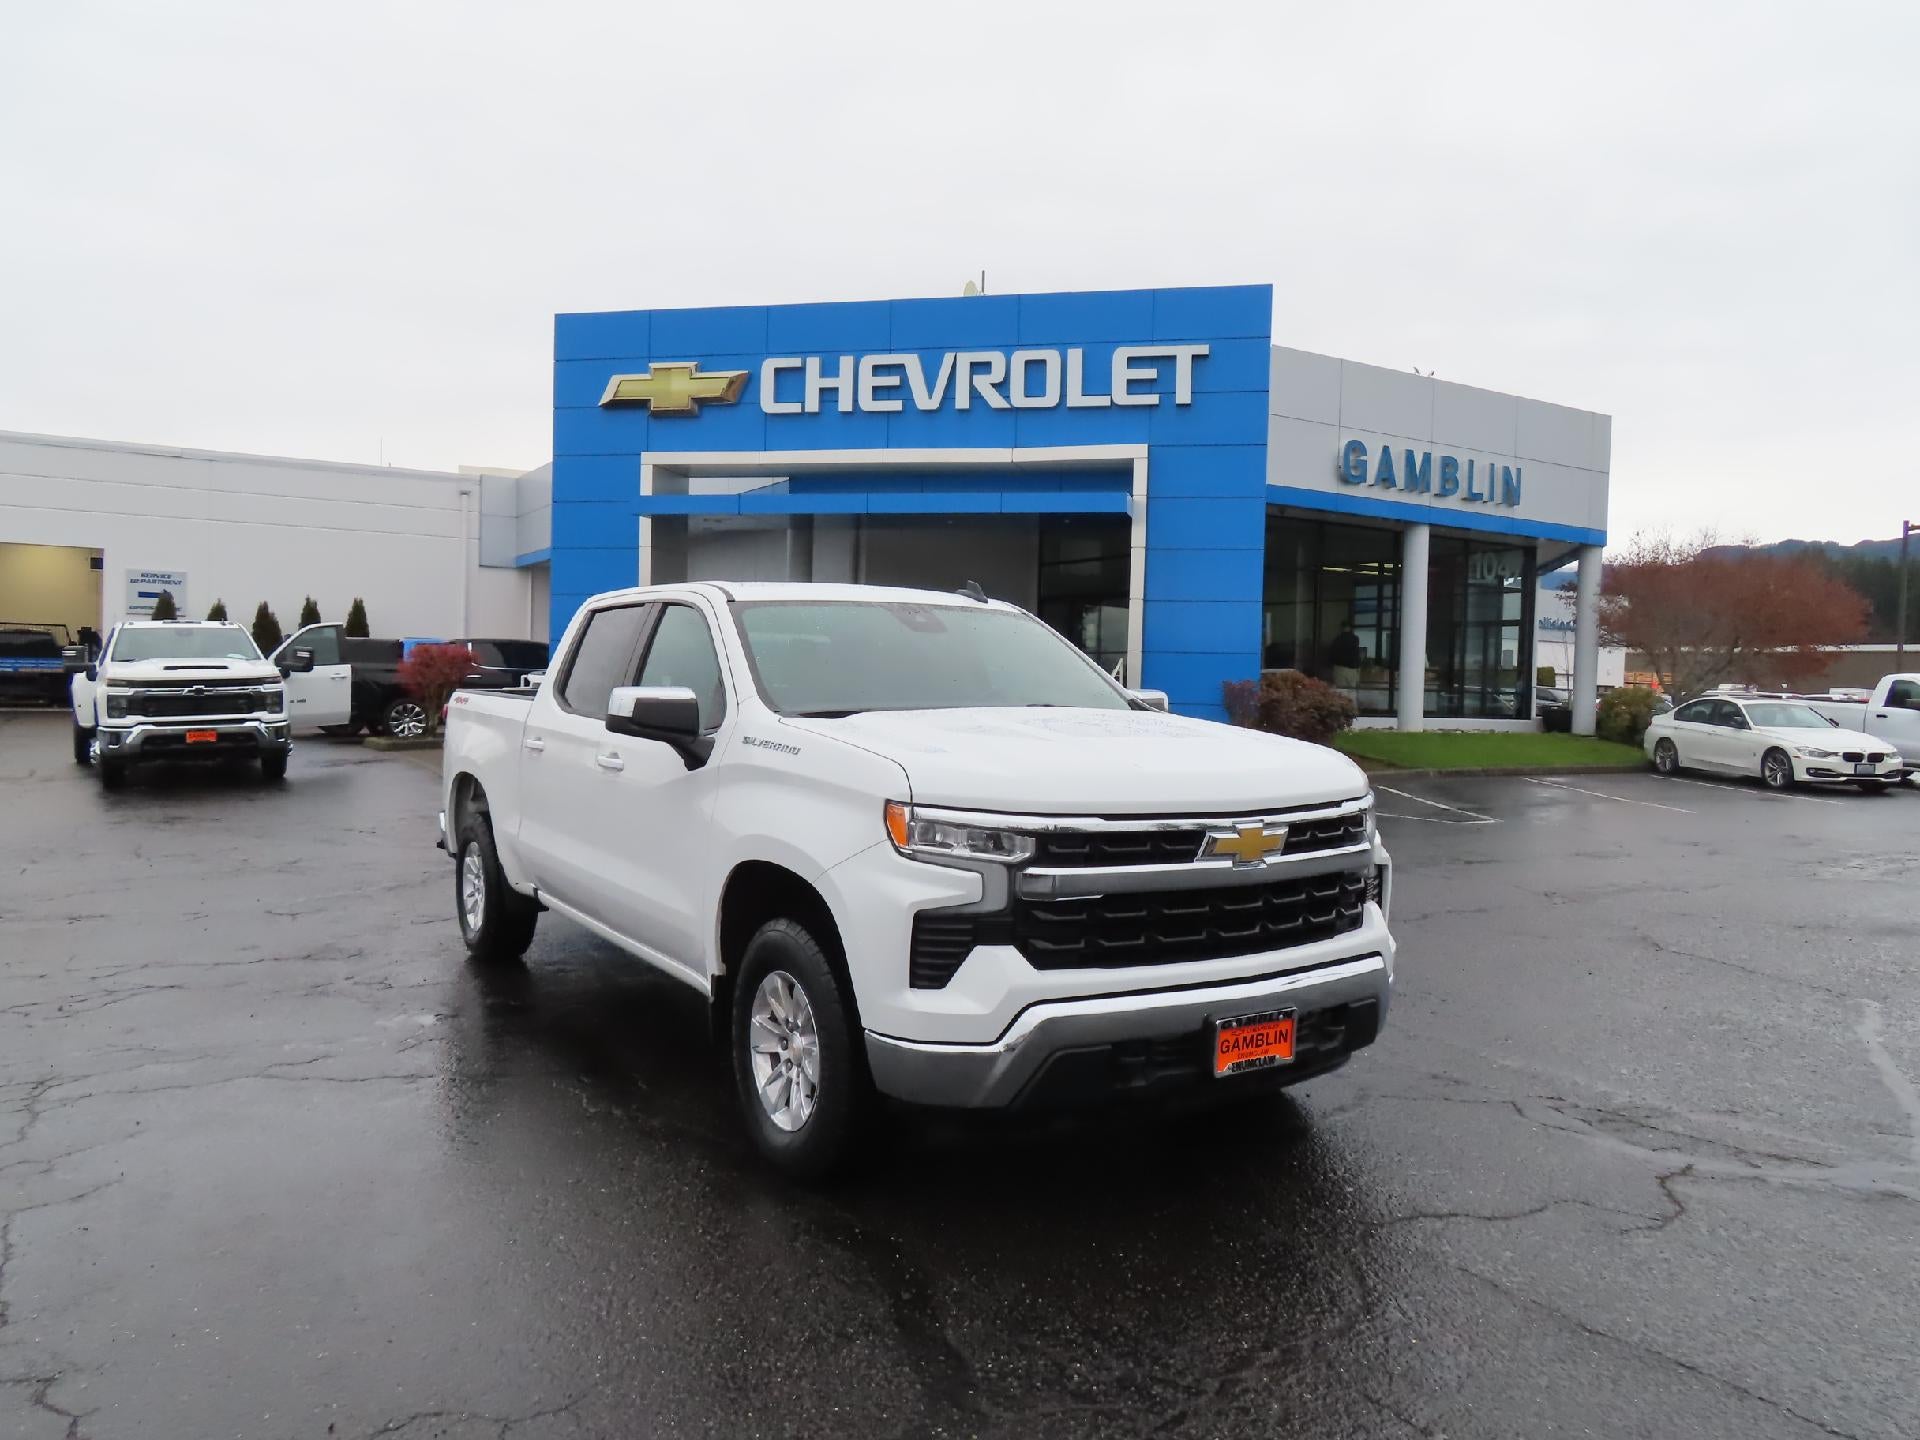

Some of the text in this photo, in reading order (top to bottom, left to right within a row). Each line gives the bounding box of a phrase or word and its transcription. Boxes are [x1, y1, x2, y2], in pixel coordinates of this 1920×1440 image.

[760, 344, 1210, 414] CHEVROLET
[1342, 439, 1522, 506] GAMBLIN
[742, 736, 801, 755] SILVERADO
[1220, 1028, 1289, 1055] GAMBLIN
